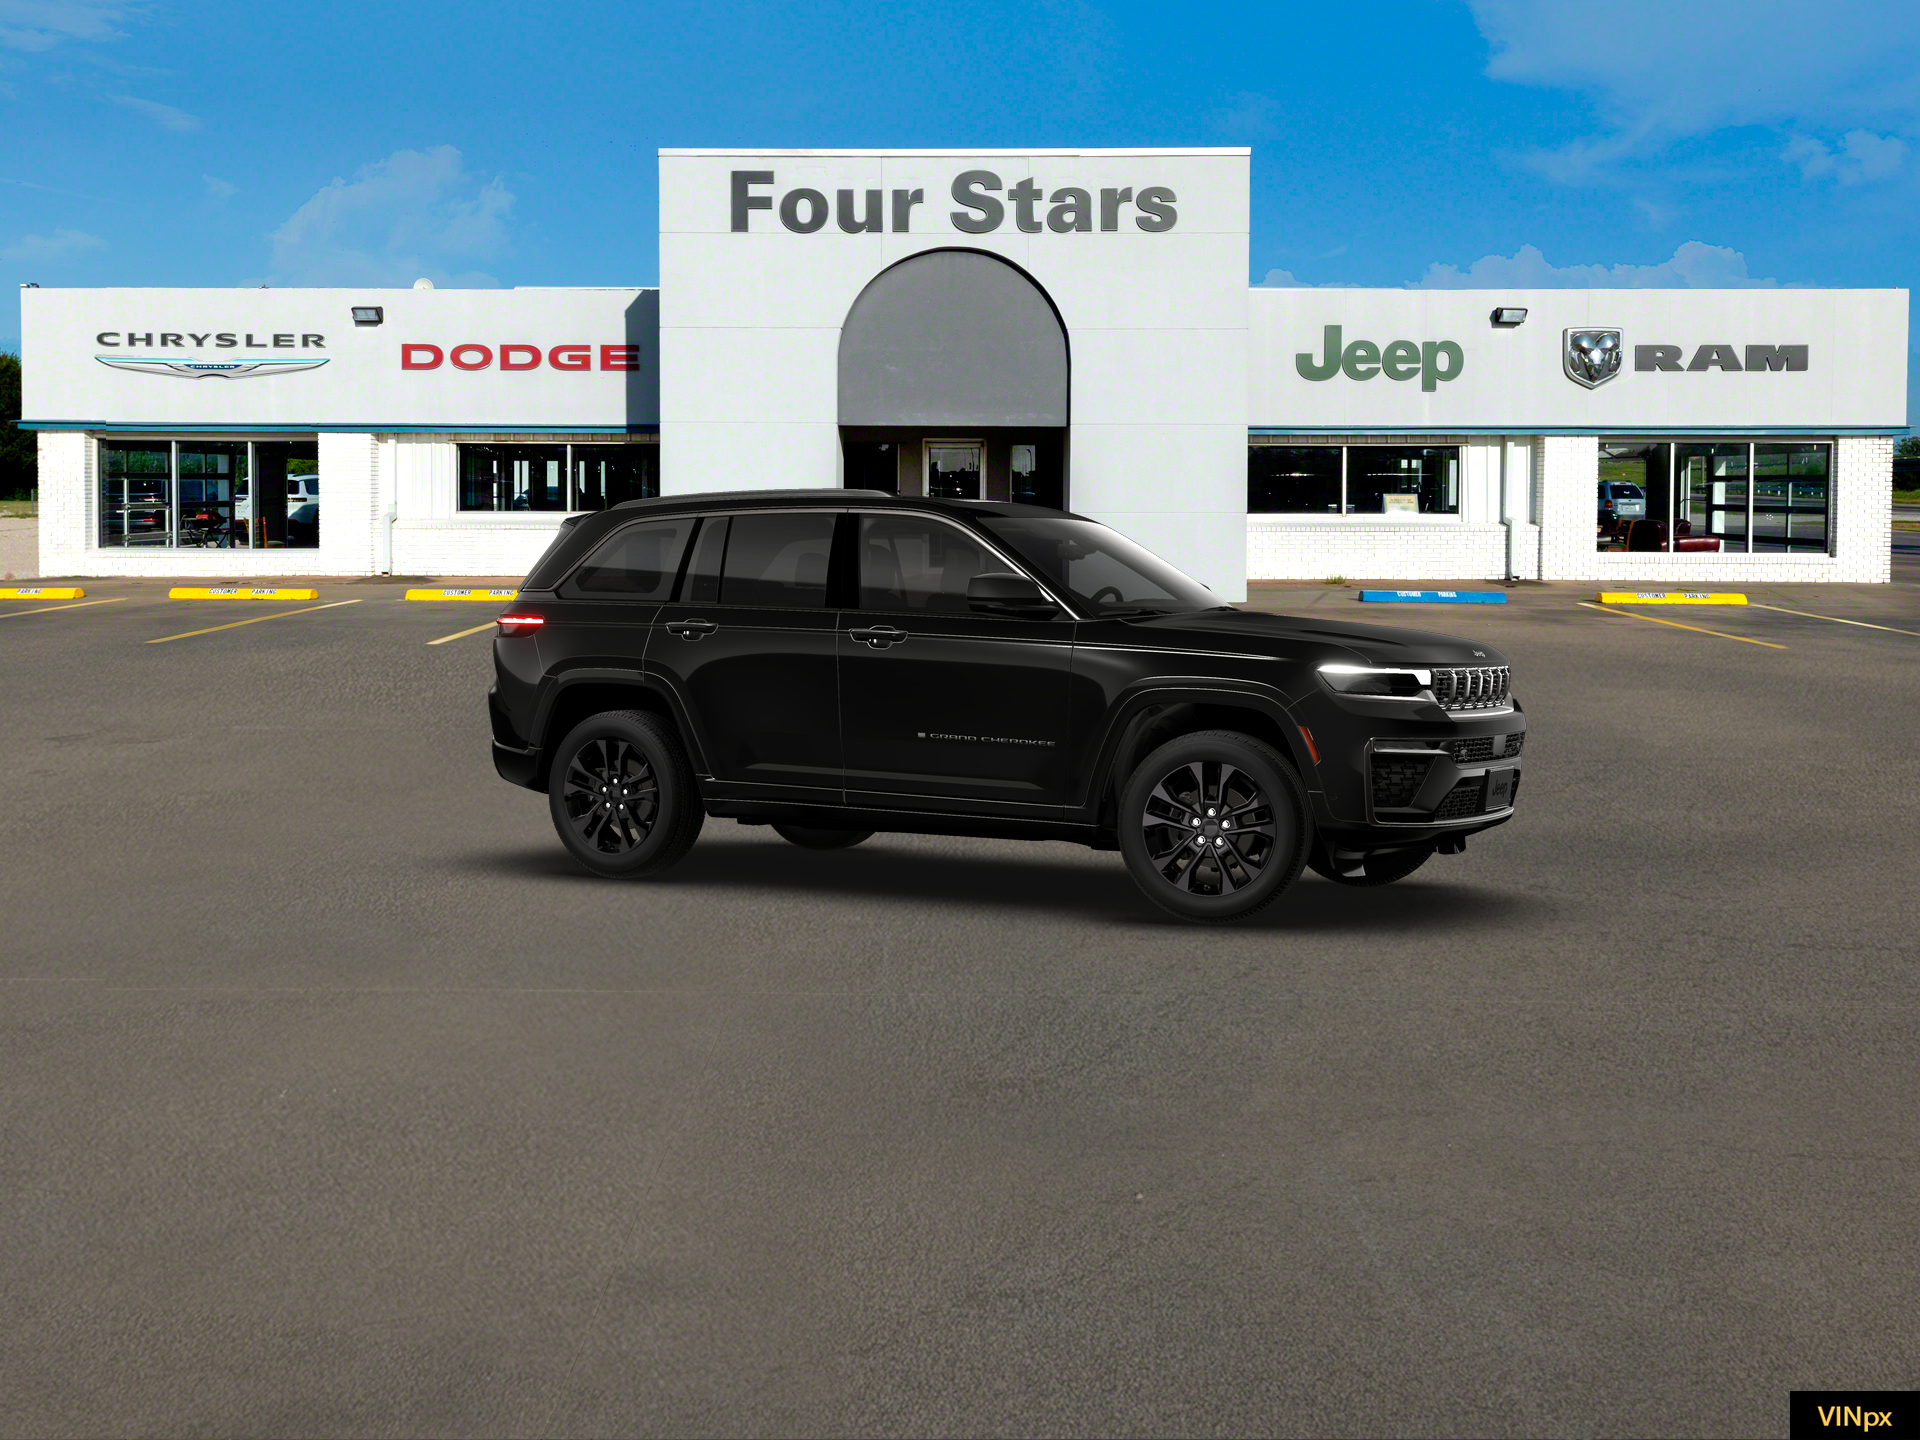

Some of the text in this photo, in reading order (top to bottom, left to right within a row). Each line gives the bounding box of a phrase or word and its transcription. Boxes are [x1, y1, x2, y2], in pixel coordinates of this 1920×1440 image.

[730, 169, 1178, 234] Four Stars
[96, 332, 327, 349] CHRYSLER
[401, 343, 641, 372] DODGE
[1295, 324, 1464, 393] Jeep
[1634, 344, 1809, 373] RAM
[930, 733, 1056, 747] GRAND CHEROKEE
[1491, 779, 1509, 798] Jeep
